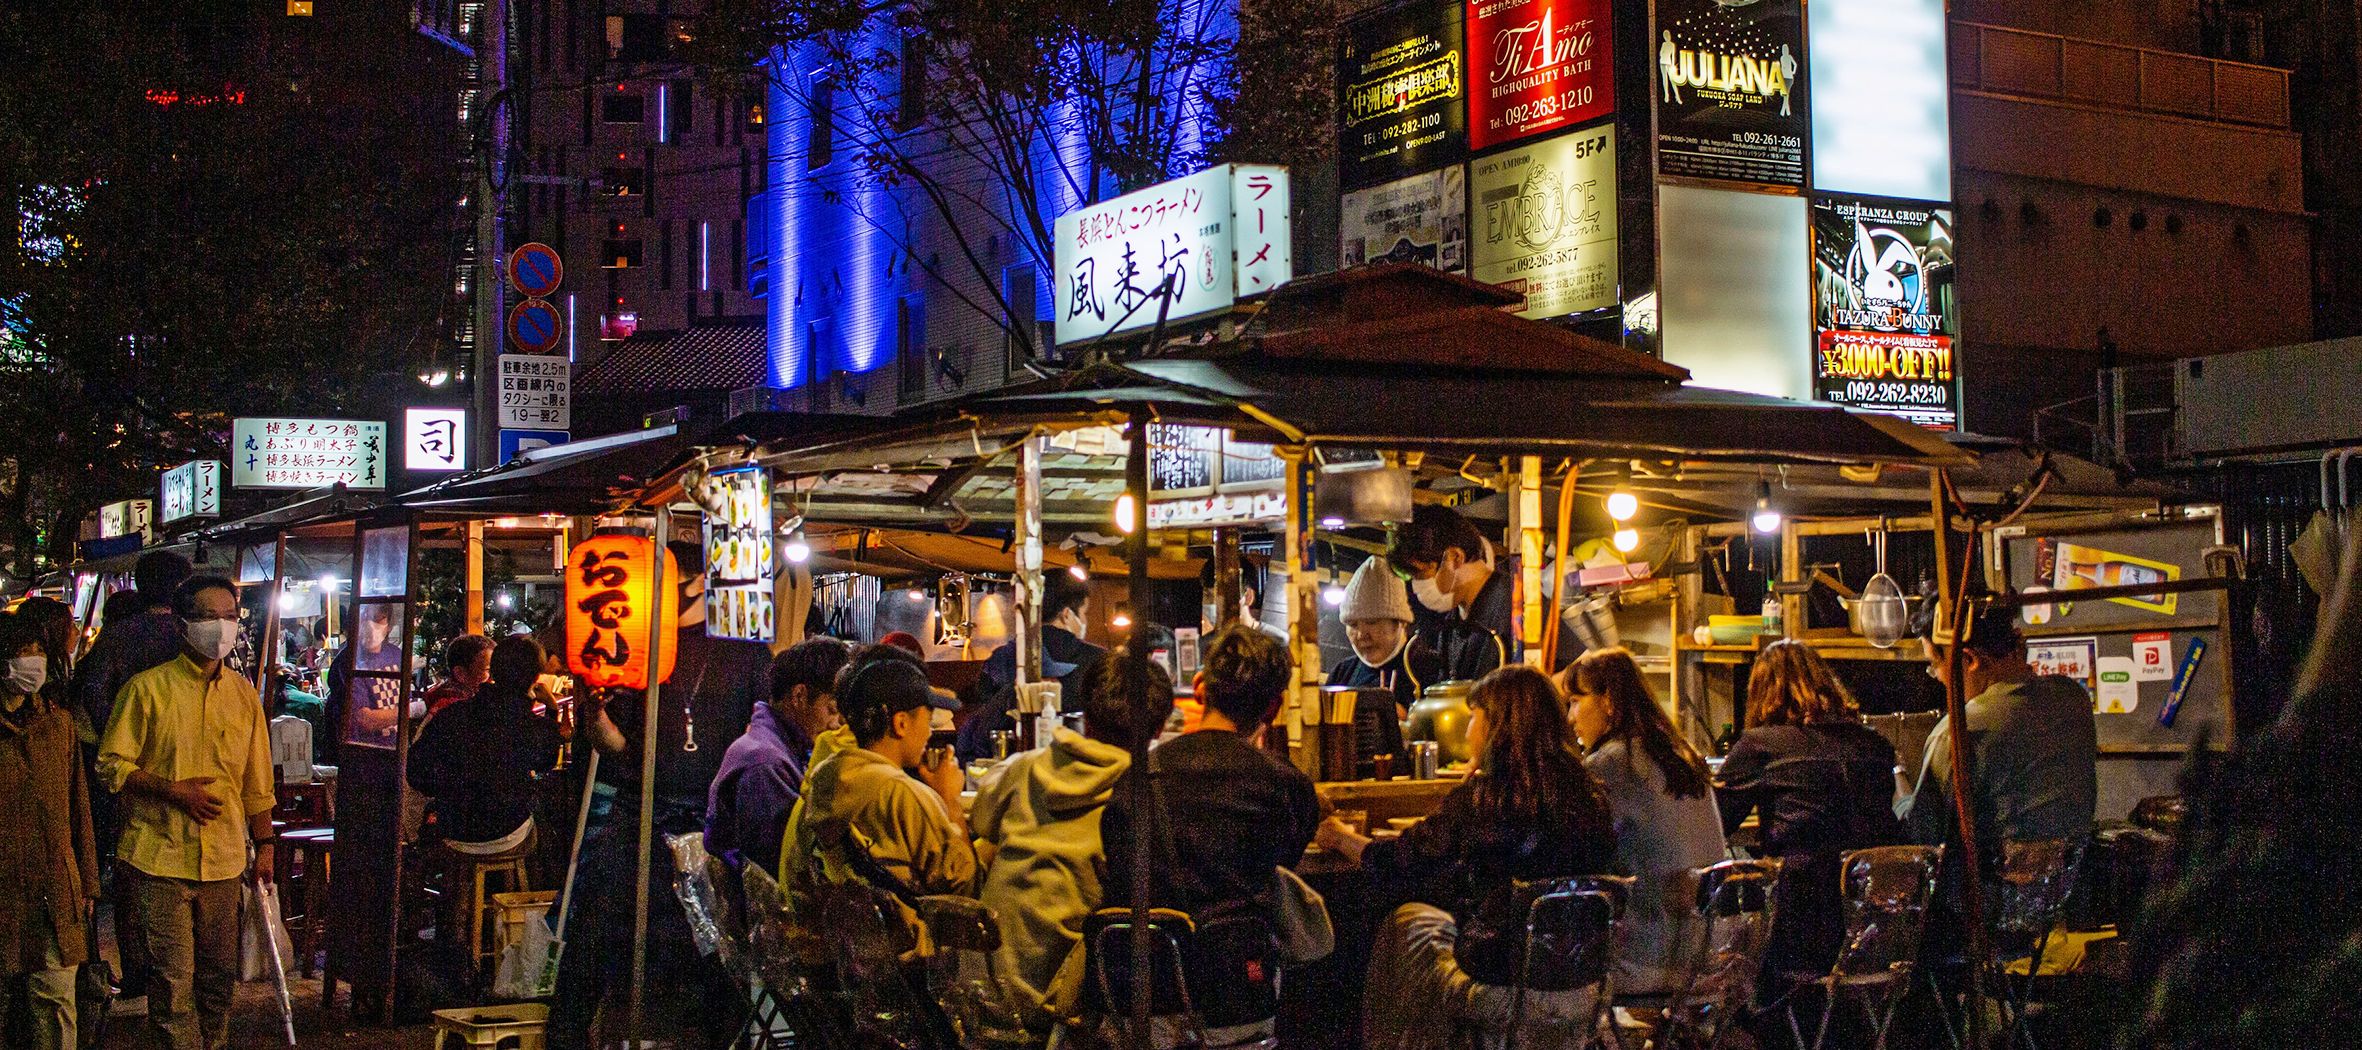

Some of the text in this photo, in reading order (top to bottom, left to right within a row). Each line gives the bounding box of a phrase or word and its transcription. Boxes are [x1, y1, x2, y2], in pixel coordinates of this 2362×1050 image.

[1492, 59, 1591, 98] HIGHQUALITY BATH
[1672, 50, 1788, 96] JULIANA
[1505, 86, 1592, 126] 092-263-1210
[1697, 90, 1762, 104] FUKUOKA SOAP LAND
[1383, 113, 1440, 139] 092-282-1100
[1576, 138, 1595, 159] 5F
[1732, 132, 1801, 148] TEL 092-261-2661
[1479, 164, 1499, 176] OPEN
[1077, 188, 1204, 249] 長浜とんこつラーメン
[1487, 180, 1600, 244] EMBRACE
[1837, 205, 1894, 219] ESPERANZA
[1896, 210, 1929, 222] GROUP
[1067, 233, 1189, 322] 風来坊
[1832, 304, 1942, 330] ITAZURA BUNNY
[503, 378, 566, 391] 区画線内の
[503, 393, 566, 406] タクシーに限る
[265, 421, 359, 437] 博多もつ鍋
[419, 419, 456, 464] 司
[245, 434, 259, 471] 丸十
[265, 437, 358, 451] あぶり明太子
[266, 453, 358, 467] 博多長浜ラーメン
[200, 461, 215, 512] ラーメン
[265, 469, 358, 484] 博多焼きラーメン
[578, 549, 631, 671] おでん
